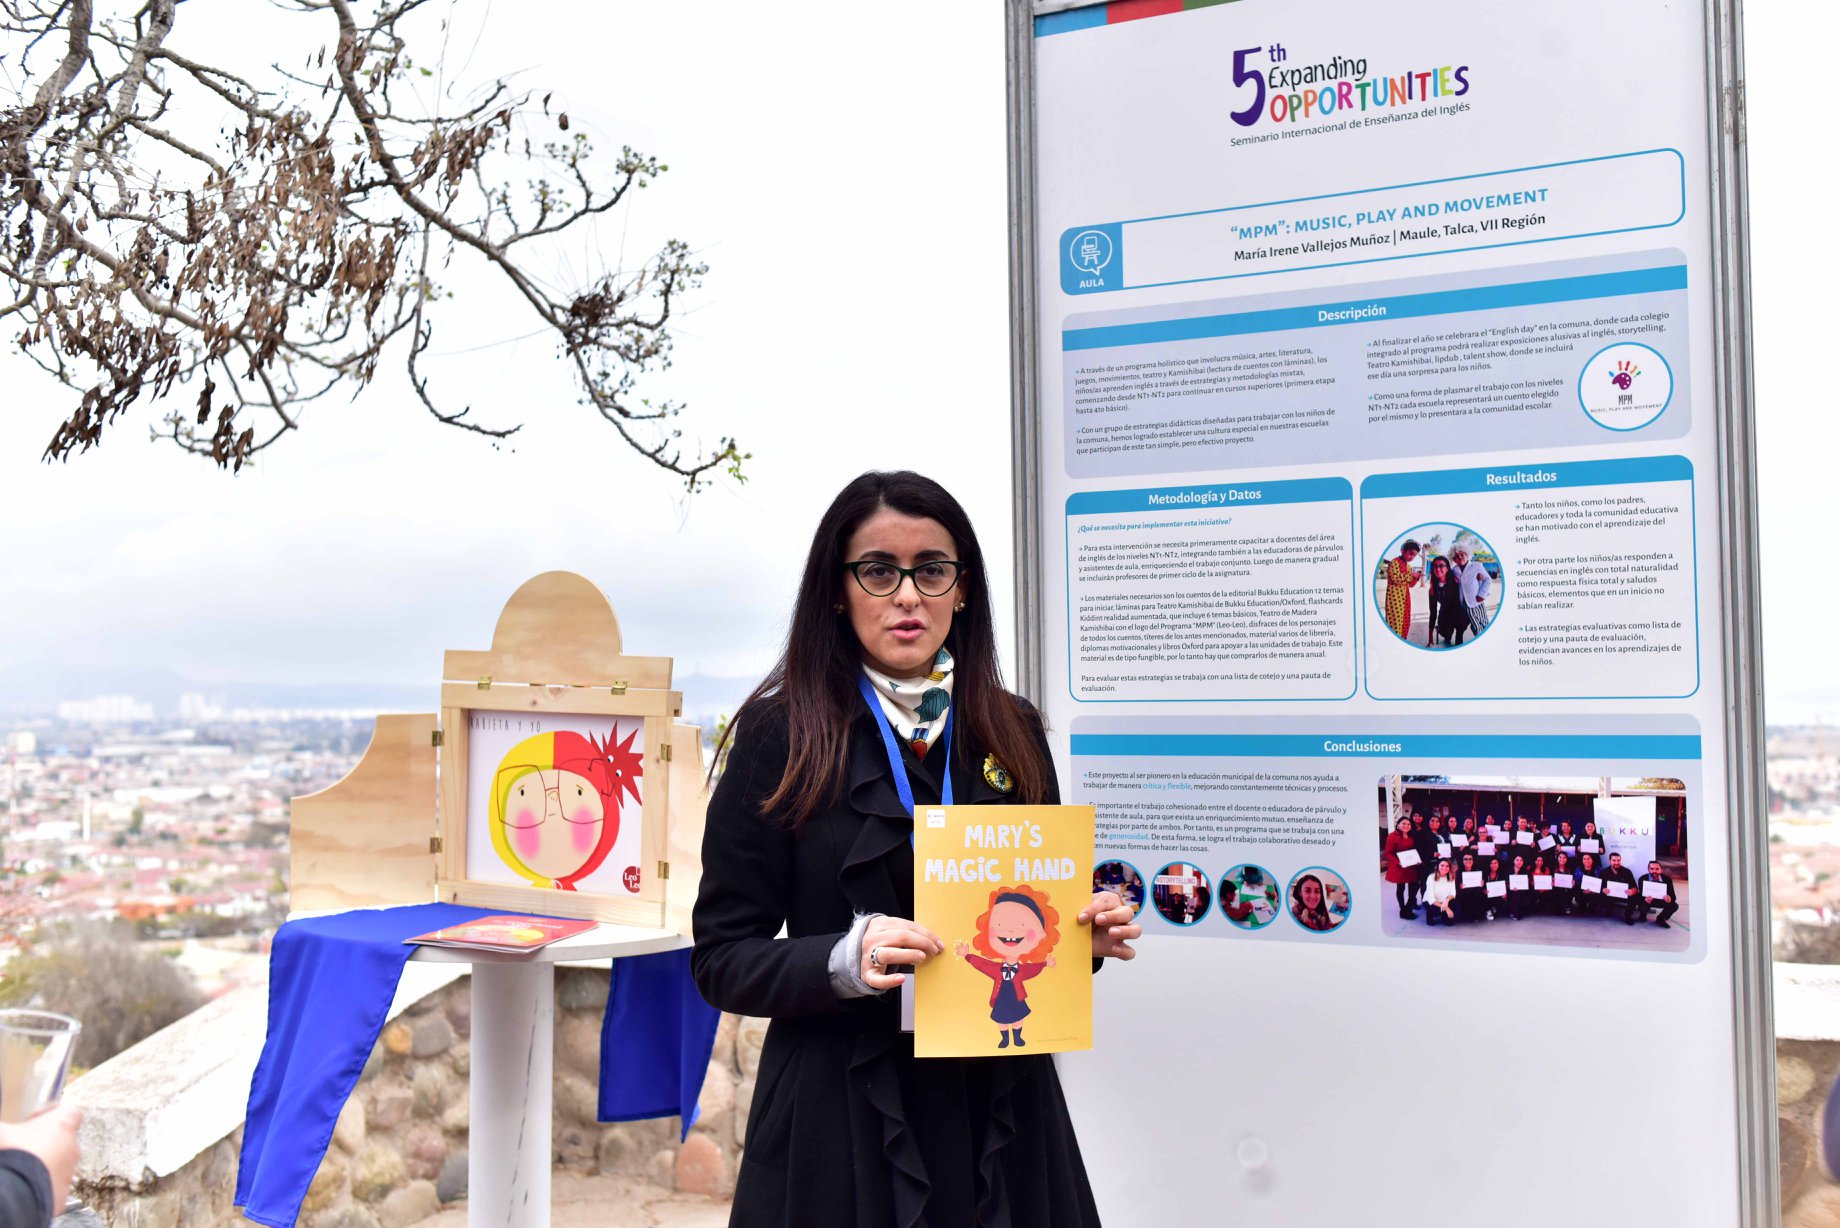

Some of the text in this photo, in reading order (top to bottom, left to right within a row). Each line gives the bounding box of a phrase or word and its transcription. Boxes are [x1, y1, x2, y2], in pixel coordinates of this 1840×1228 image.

[1268, 55, 1368, 91] Expanding
[1269, 65, 1470, 123] OPPORTUNITIES
[1230, 101, 1470, 147] Seminario Internacional de Enseñanza del Inglés
[1230, 188, 1548, 240] “MPM”: MUSIC, PLAY AND MOVEMENT
[1234, 212, 1545, 261] María Irene Vallejos Muñoz Maule, Talca, VII Región
[1079, 278, 1105, 289] AULA
[1317, 304, 1386, 323] Descripción
[1381, 337, 1412, 346] finalizar
[1420, 334, 1435, 343] año
[1444, 330, 1479, 340] celebrara
[1558, 320, 1592, 329] comuna,
[1592, 316, 1619, 326] donde
[1619, 314, 1639, 323] cada
[1639, 311, 1669, 321] colegio
[1618, 394, 1633, 406] MPM
[1486, 469, 1557, 485] Resultados
[1148, 489, 1262, 505] Metodología y Datos
[1522, 501, 1543, 509] Tanto
[1544, 500, 1556, 508] los
[1556, 499, 1580, 507] niños,
[1604, 496, 1616, 505] los
[1616, 495, 1646, 506] padres,
[1514, 505, 1678, 521] educadores y toda la comunidad educativa
[1524, 523, 1540, 531] han
[1541, 521, 1578, 530] motivado
[1594, 519, 1602, 528] el
[1603, 518, 1651, 529] aprendizaje
[1652, 516, 1666, 525] del
[1112, 542, 1153, 550] intervención
[1161, 540, 1189, 548] necesita
[1189, 538, 1237, 548] primeramente
[1238, 536, 1269, 546] capacitar
[1275, 535, 1306, 543] docentes
[1306, 534, 1318, 542] del
[1319, 533, 1335, 541] área
[1515, 534, 1540, 544] inglés.
[1523, 557, 1536, 565] Por
[1554, 556, 1575, 565] parte
[1576, 554, 1588, 563] los
[1589, 553, 1623, 562] niños/as
[1623, 551, 1667, 562] responden
[1516, 567, 1557, 576] secuencias
[1569, 566, 1594, 576] inglés
[1610, 564, 1629, 573] total
[1630, 562, 1679, 572] naturalidad
[1516, 580, 1538, 588] como
[1539, 579, 1577, 588] respuesta
[1578, 577, 1599, 585] física
[1599, 576, 1619, 584] total
[1626, 574, 1657, 584] saludos
[1517, 590, 1547, 599] básicos,
[1547, 589, 1589, 598] elementos
[1590, 590, 1606, 598] que
[1630, 586, 1653, 595] inicio
[1517, 600, 1574, 610] sabían realizar.
[1518, 657, 1554, 666] los niños.
[517, 720, 522, 732] Y
[530, 720, 541, 733] YO
[1323, 740, 1401, 752] Conclusiones
[1082, 781, 1108, 789] trabajar
[1108, 781, 1117, 789] de
[1142, 781, 1162, 789] crítica
[1161, 783, 1167, 791] y
[1166, 781, 1193, 790] flexible,
[1193, 782, 1229, 791] mejorando
[1284, 783, 1312, 792] técnicas
[624, 872, 638, 881] Leo
[1014, 857, 1076, 882] HAND
[629, 880, 641, 889] Le
[1156, 876, 1196, 885] #STORYTELLING
